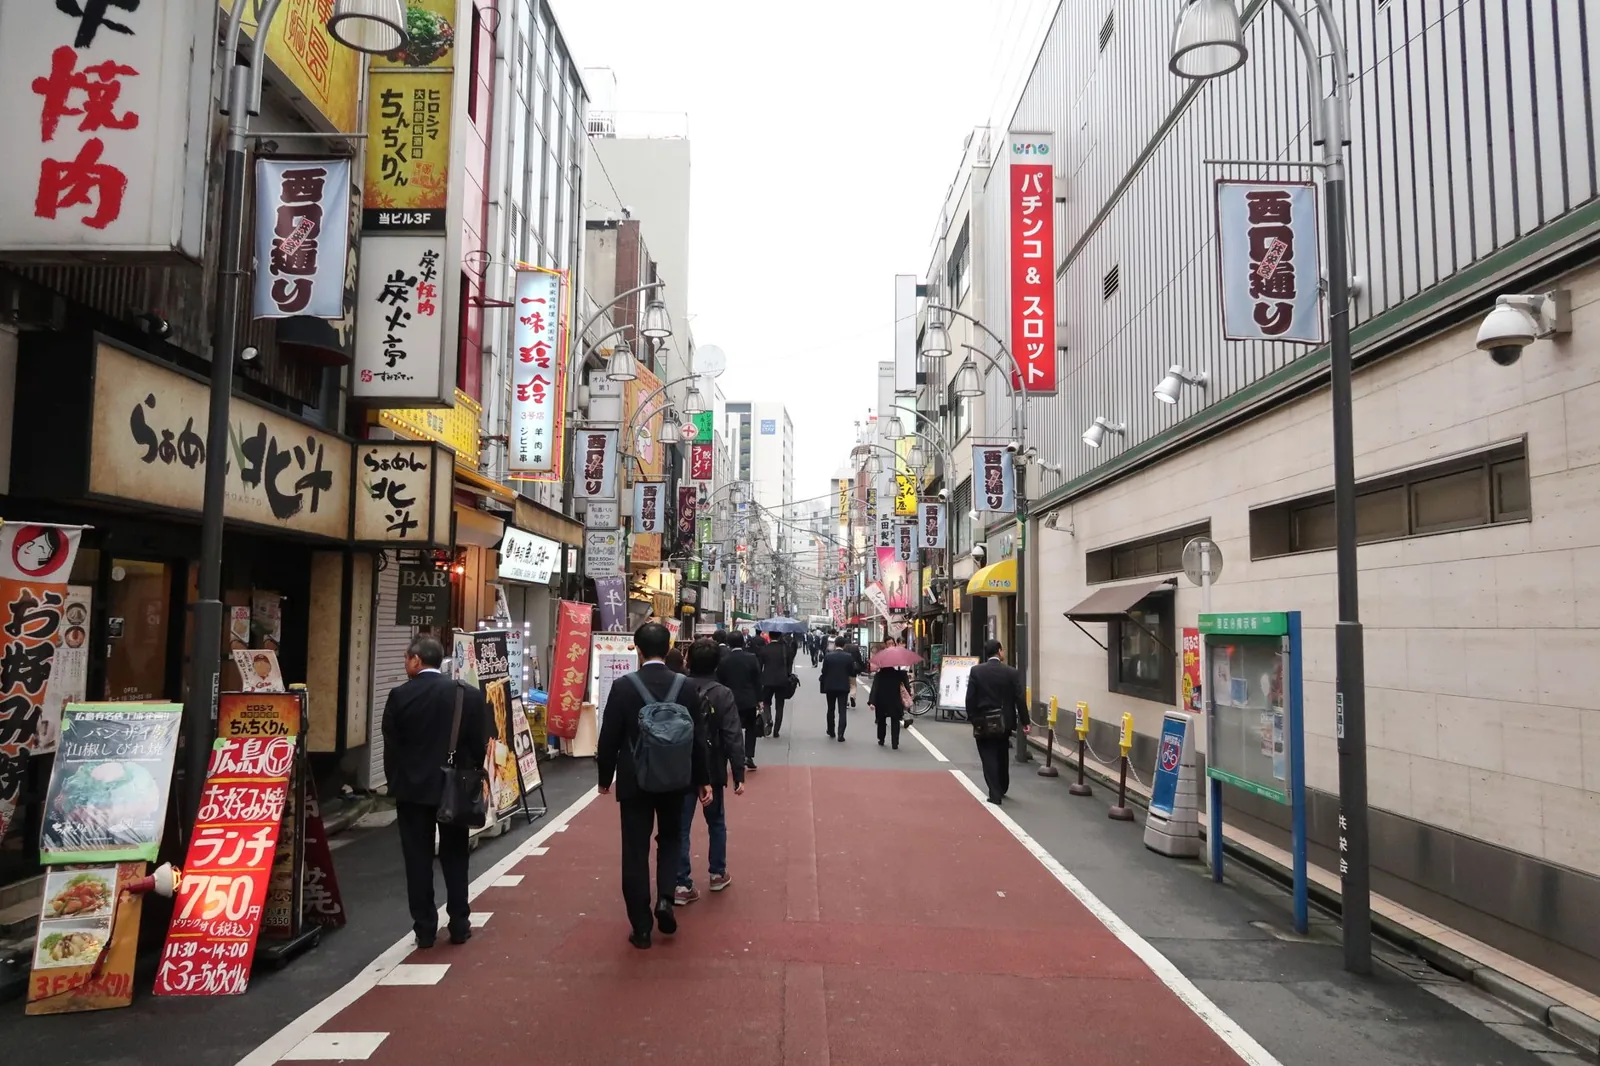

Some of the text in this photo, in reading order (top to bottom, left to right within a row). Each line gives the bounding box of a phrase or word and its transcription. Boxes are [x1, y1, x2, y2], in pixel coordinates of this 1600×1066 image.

[426, 89, 441, 140] ヒロシマ
[381, 88, 410, 187] ちんちくりん
[1012, 143, 1050, 155] uno
[379, 212, 432, 225] 当ビル3F
[270, 167, 328, 314] 西口通り
[416, 249, 440, 317] 炭火焼肉
[1021, 172, 1045, 384] パチンコ & スロット
[1245, 190, 1297, 336] 西口通り
[376, 269, 418, 368] 炭火亭
[516, 296, 552, 404] 一味玲玲
[364, 448, 427, 472] らぁめん
[692, 446, 702, 478] ラーメン
[702, 450, 712, 471] 餃子
[371, 477, 419, 538] 北斗
[402, 570, 447, 588] BAR
[411, 592, 435, 603] EST
[410, 615, 434, 625] B1F
[230, 719, 290, 736] ちんちくりん
[198, 785, 284, 823] お好み焼
[193, 826, 275, 869] ランチ
[180, 874, 261, 922] 750円
